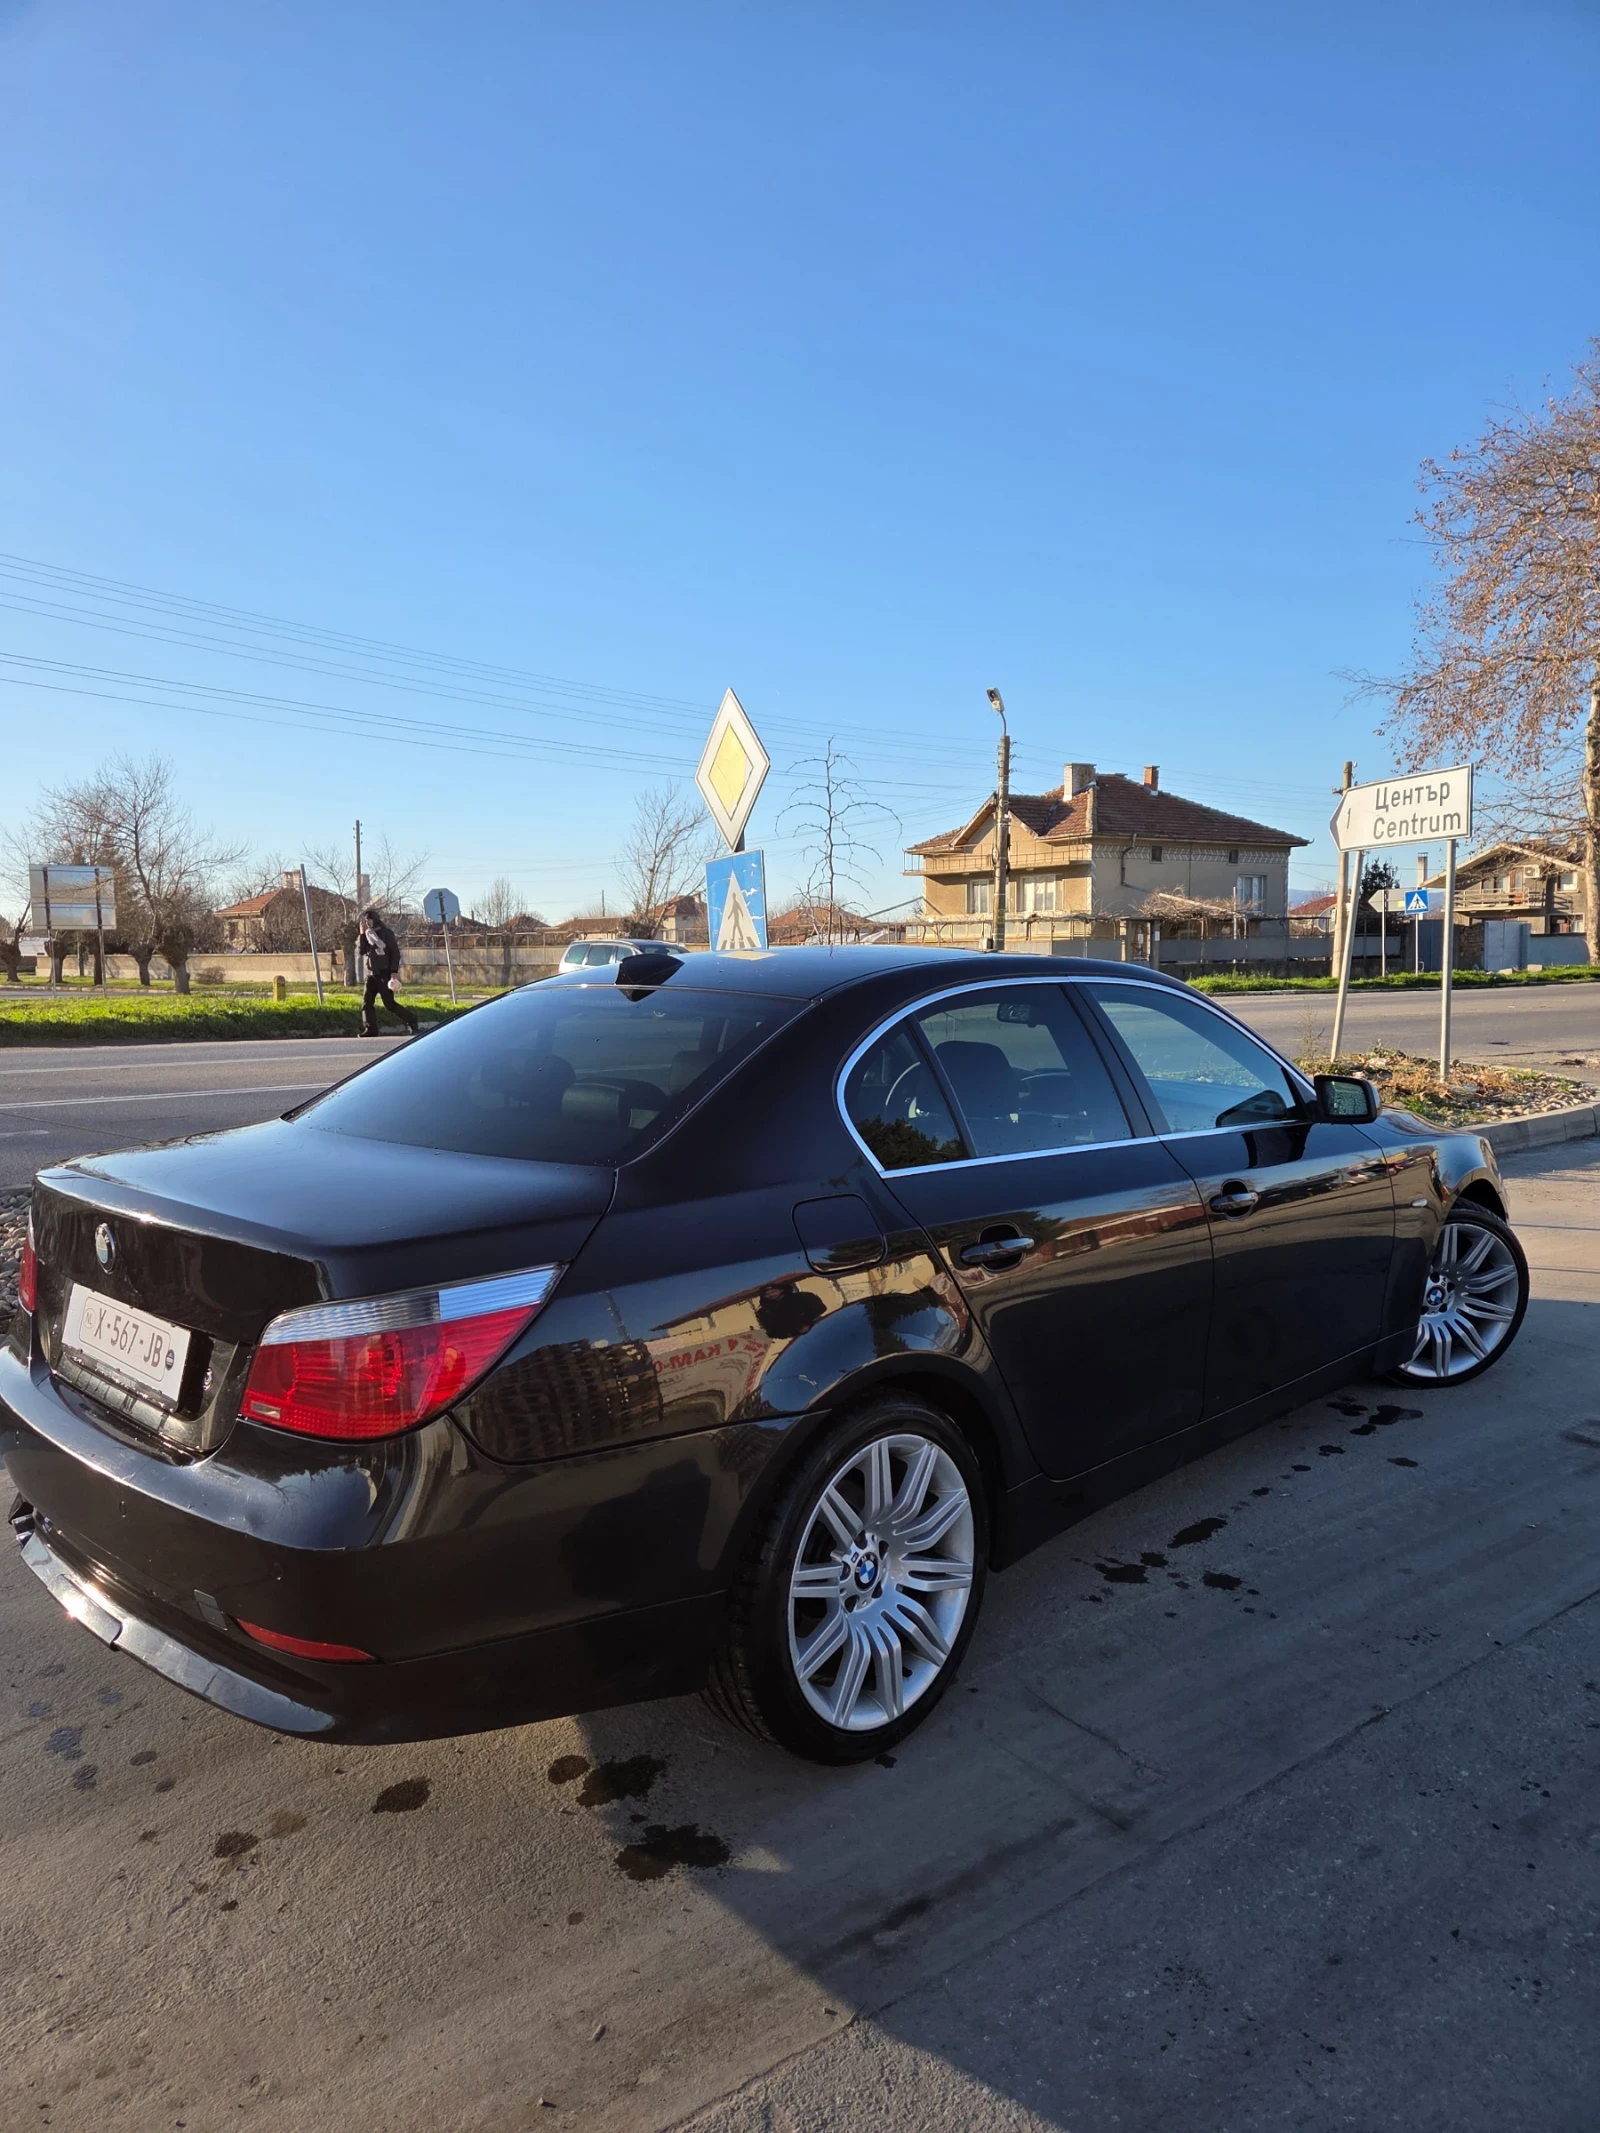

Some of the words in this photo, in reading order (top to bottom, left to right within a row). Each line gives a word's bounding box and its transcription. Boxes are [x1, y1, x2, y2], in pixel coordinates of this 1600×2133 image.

[1376, 781, 1450, 813] Център
[1373, 811, 1461, 840] Centrum
[94, 1308, 163, 1368] X-567-JB
